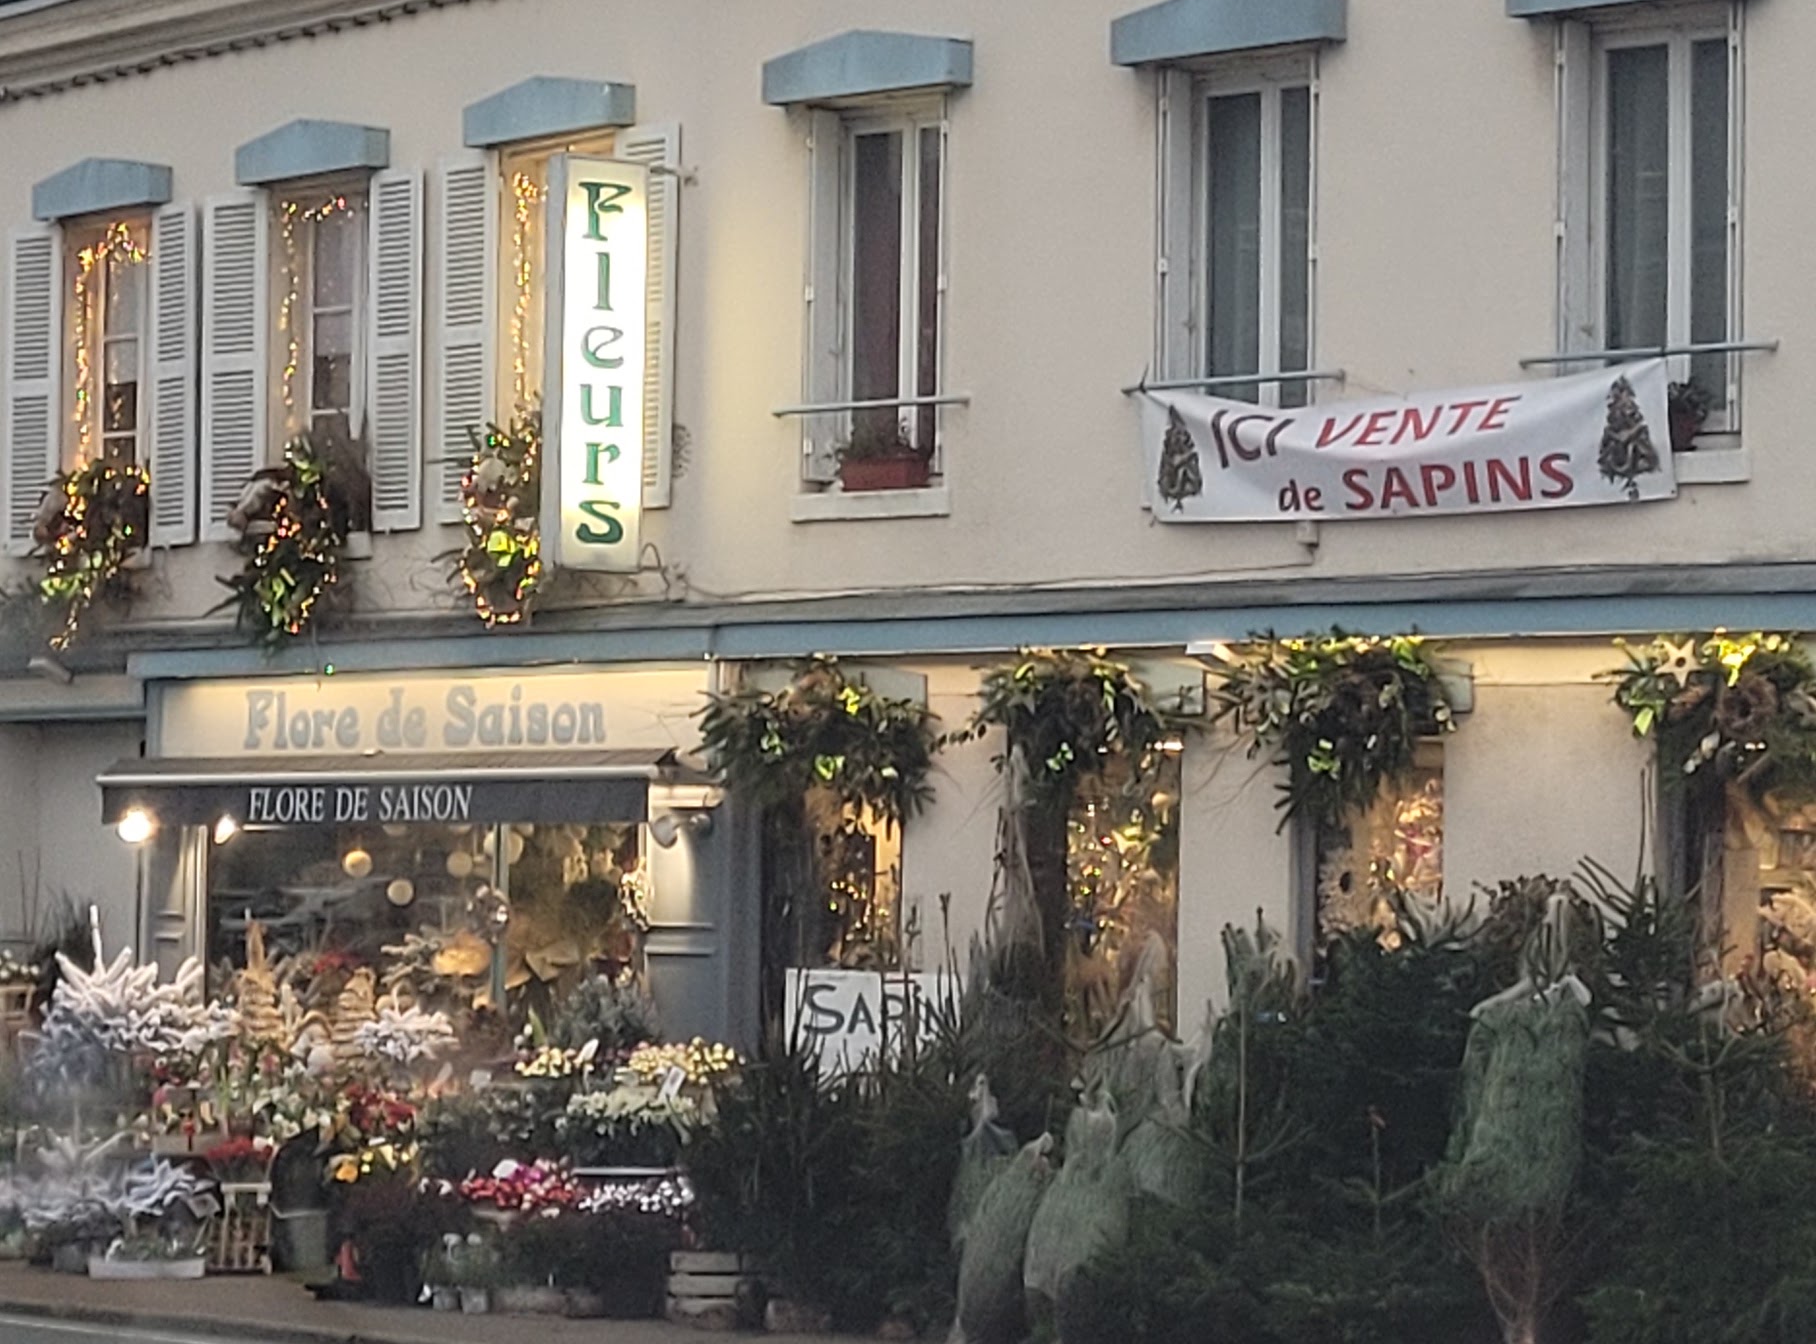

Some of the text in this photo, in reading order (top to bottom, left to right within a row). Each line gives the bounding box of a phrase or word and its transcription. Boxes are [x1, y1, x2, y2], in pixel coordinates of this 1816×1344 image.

[575, 180, 632, 544] Fleurs
[1210, 395, 1522, 468] ICI VENTE
[1277, 453, 1574, 512] de SAPINS
[243, 683, 606, 750] Flore de Saison
[248, 785, 473, 823] FLORE DE SAISON
